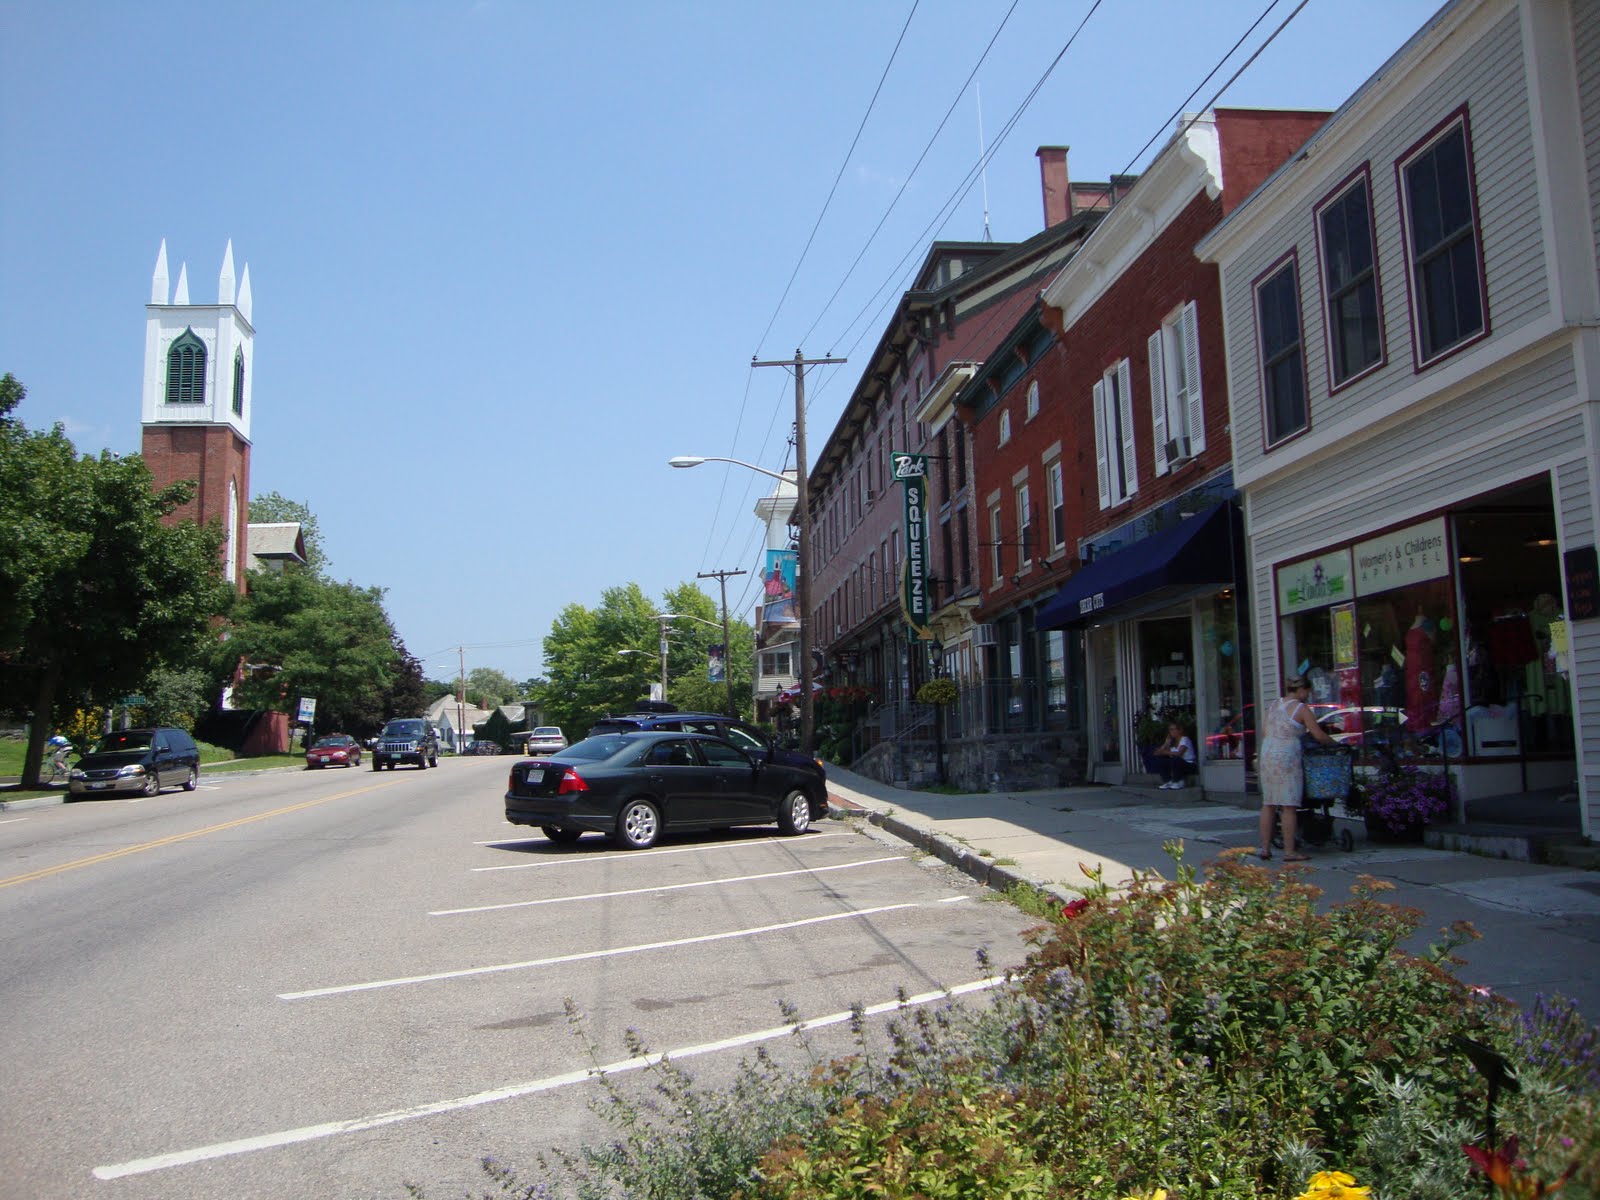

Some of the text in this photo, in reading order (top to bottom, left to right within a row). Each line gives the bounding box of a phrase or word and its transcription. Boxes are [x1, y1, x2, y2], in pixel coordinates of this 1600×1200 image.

[895, 456, 924, 476] Park
[908, 487, 923, 614] SQUEEZE
[1359, 547, 1392, 569] Women's
[1395, 545, 1402, 559] &
[1362, 552, 1441, 581] APPAREL
